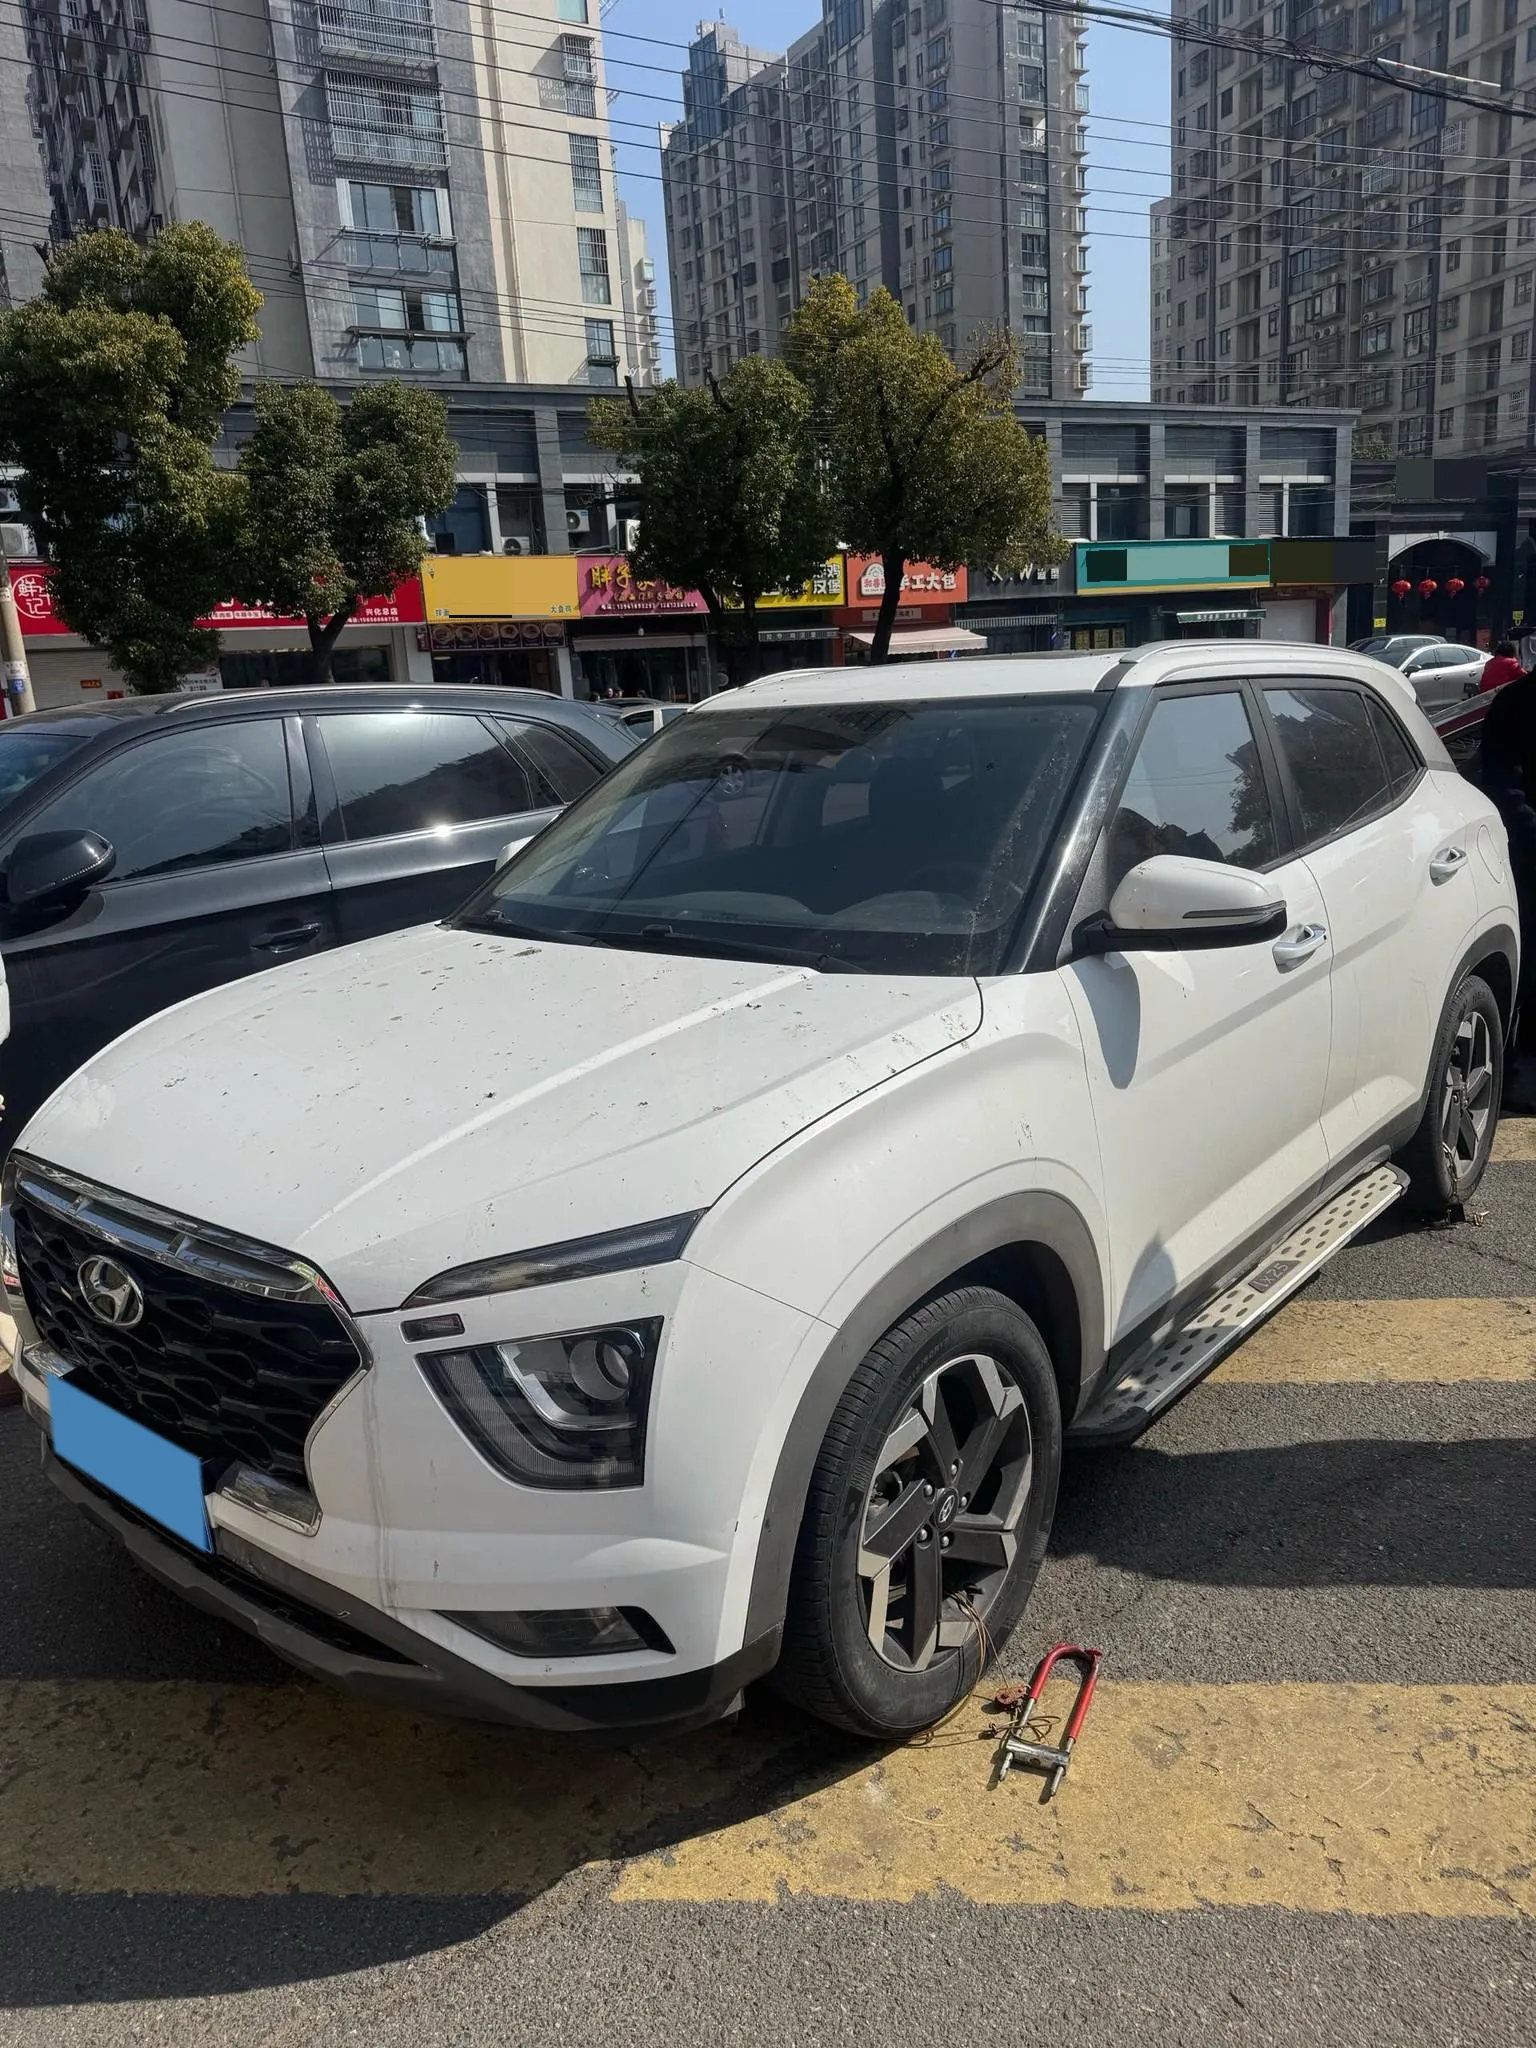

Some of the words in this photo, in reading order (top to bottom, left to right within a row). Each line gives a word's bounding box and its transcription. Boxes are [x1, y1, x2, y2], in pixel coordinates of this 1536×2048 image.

[813, 579, 841, 594] 汉堡
[365, 607, 399, 616] 兴化总店
